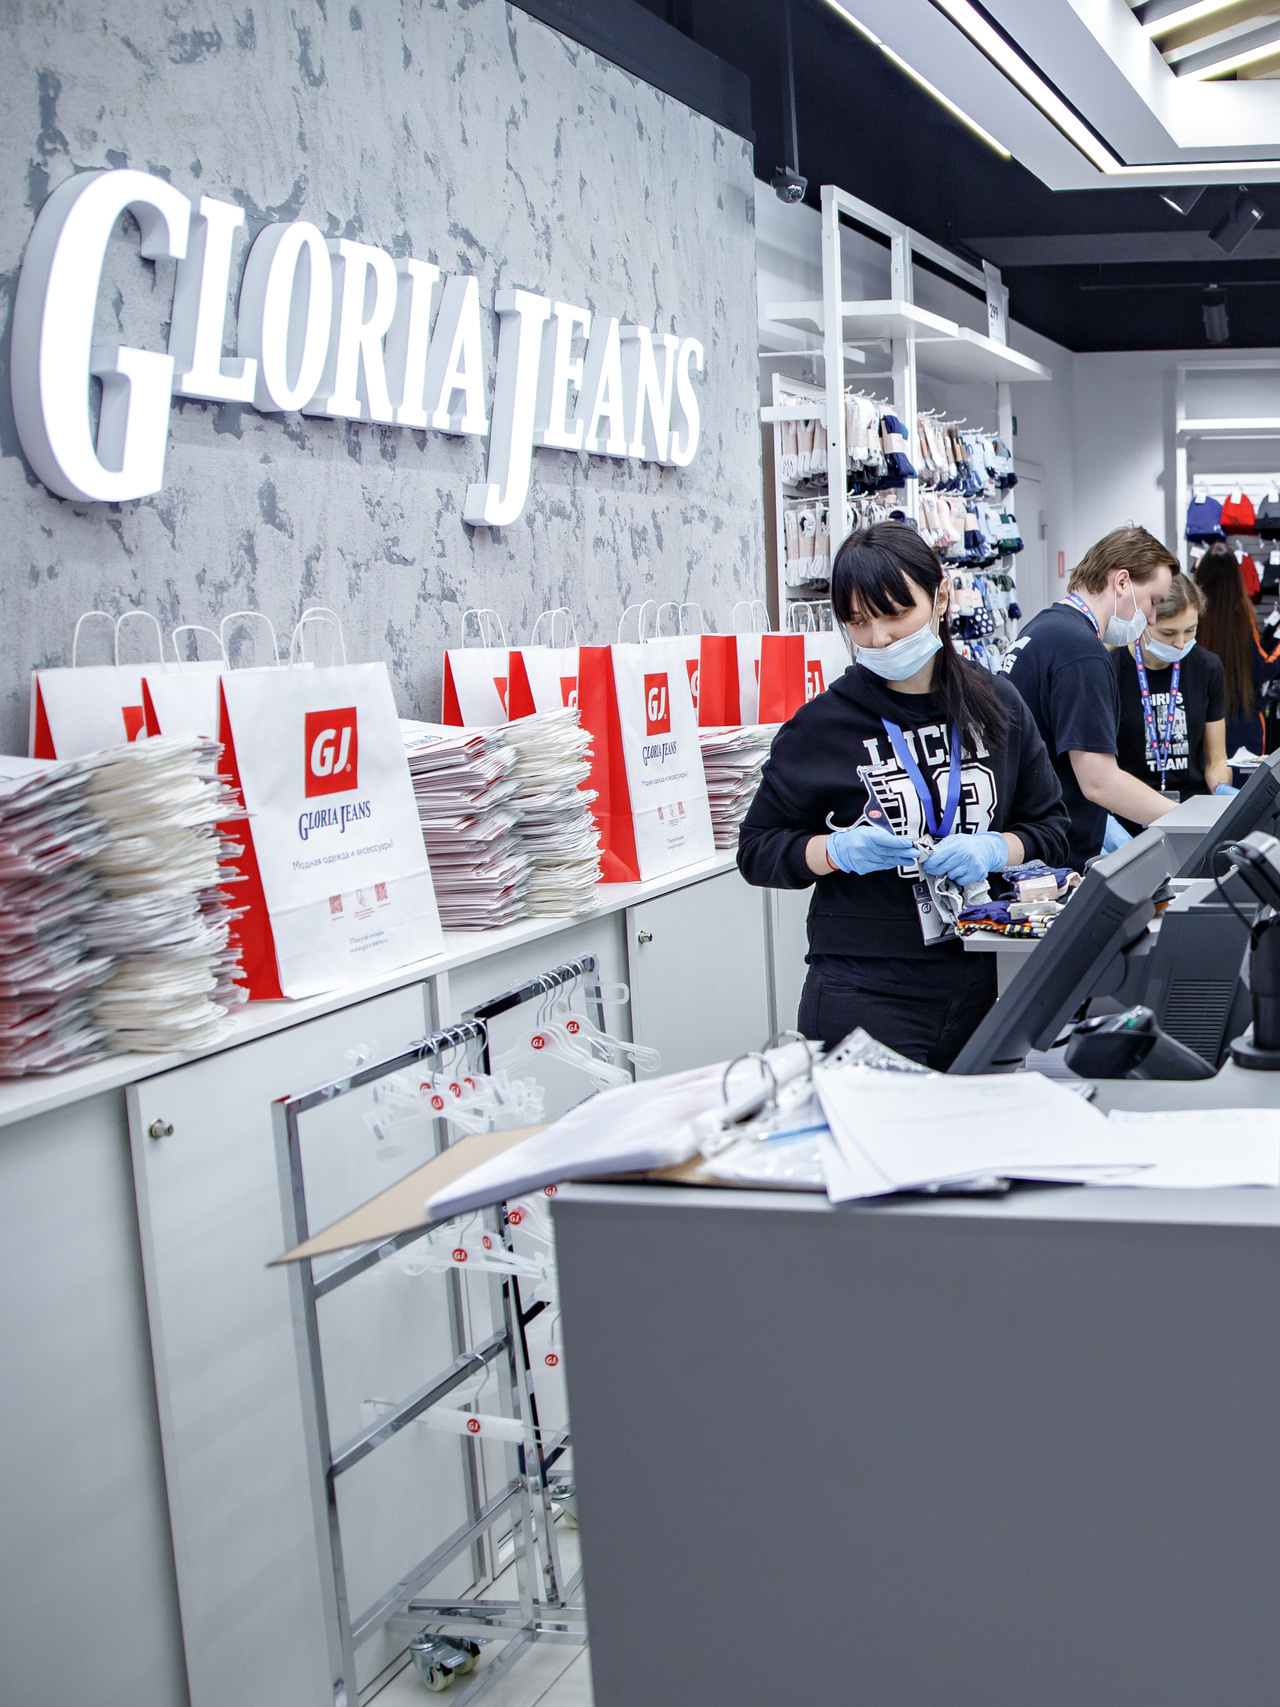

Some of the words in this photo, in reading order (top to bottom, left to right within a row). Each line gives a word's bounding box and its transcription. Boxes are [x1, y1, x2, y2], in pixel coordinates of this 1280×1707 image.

[989, 303, 999, 321] 299
[12, 168, 490, 502] GLORIA
[464, 288, 705, 527] JEANS
[647, 686, 666, 722] GJ
[310, 726, 352, 778] GJ
[642, 744, 662, 766] GLORIA
[661, 741, 677, 764] JEANS
[1146, 757, 1189, 773] TEAM
[298, 808, 339, 841] GLORIA
[339, 800, 372, 834] JEANS
[292, 857, 322, 871] Модная
[322, 851, 350, 864] одежда
[356, 839, 394, 856] аксессуары!
[568, 1024, 579, 1032] GJ
[532, 1039, 544, 1047] GJ
[509, 1214, 520, 1223] GJ
[453, 1251, 465, 1259] GJ
[546, 1356, 557, 1365] GJ
[468, 1421, 480, 1430] GJ
